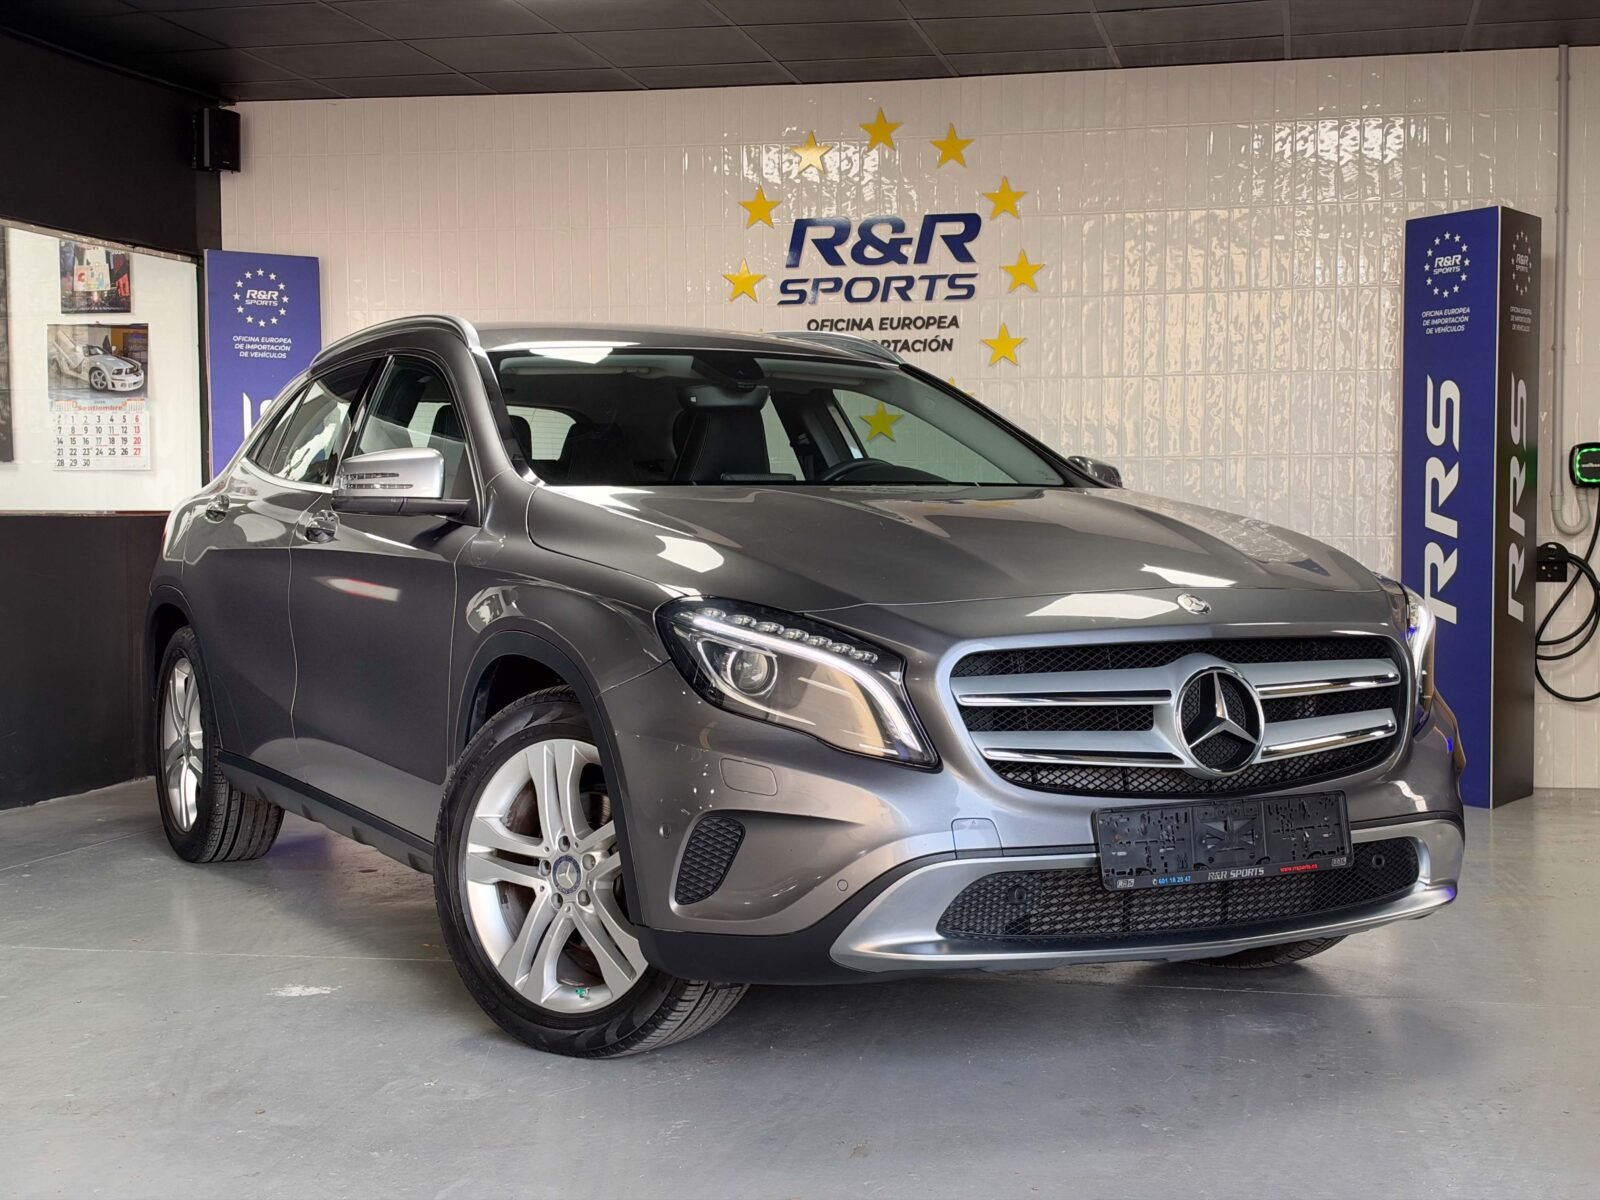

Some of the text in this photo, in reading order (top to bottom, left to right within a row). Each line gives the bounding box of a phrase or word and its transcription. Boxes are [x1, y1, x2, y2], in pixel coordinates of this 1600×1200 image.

[786, 213, 982, 268] R&R
[1434, 255, 1462, 267] R&R
[1433, 266, 1460, 275] SPORTS
[777, 273, 978, 305] SPORTS
[246, 289, 279, 300] R&R
[1422, 307, 1470, 318] OFICINA EUROPEA
[807, 315, 960, 332] OFICINA EUROPEA
[1431, 316, 1469, 325] IMPORTACIÓN
[1435, 325, 1465, 334] VEHÍCULOS
[233, 335, 260, 343] OFICINA
[245, 343, 290, 351] IMPORTACIÓN
[870, 335, 954, 353] RTACIÓN
[250, 351, 287, 359] VEHÍCULOS
[71, 415, 139, 423] 1 2 3 4 5 6
[57, 426, 140, 434] 7 8 9 10 11 12 13
[57, 437, 141, 445] 14 15 16 17 18 19 20
[57, 448, 141, 456] 21 22 23 24 25 26 27
[57, 459, 90, 467] 28 29 30
[1424, 373, 1460, 625] RRS
[1508, 371, 1527, 623] RRS
[1207, 867, 1265, 880] R&R SPORTS
